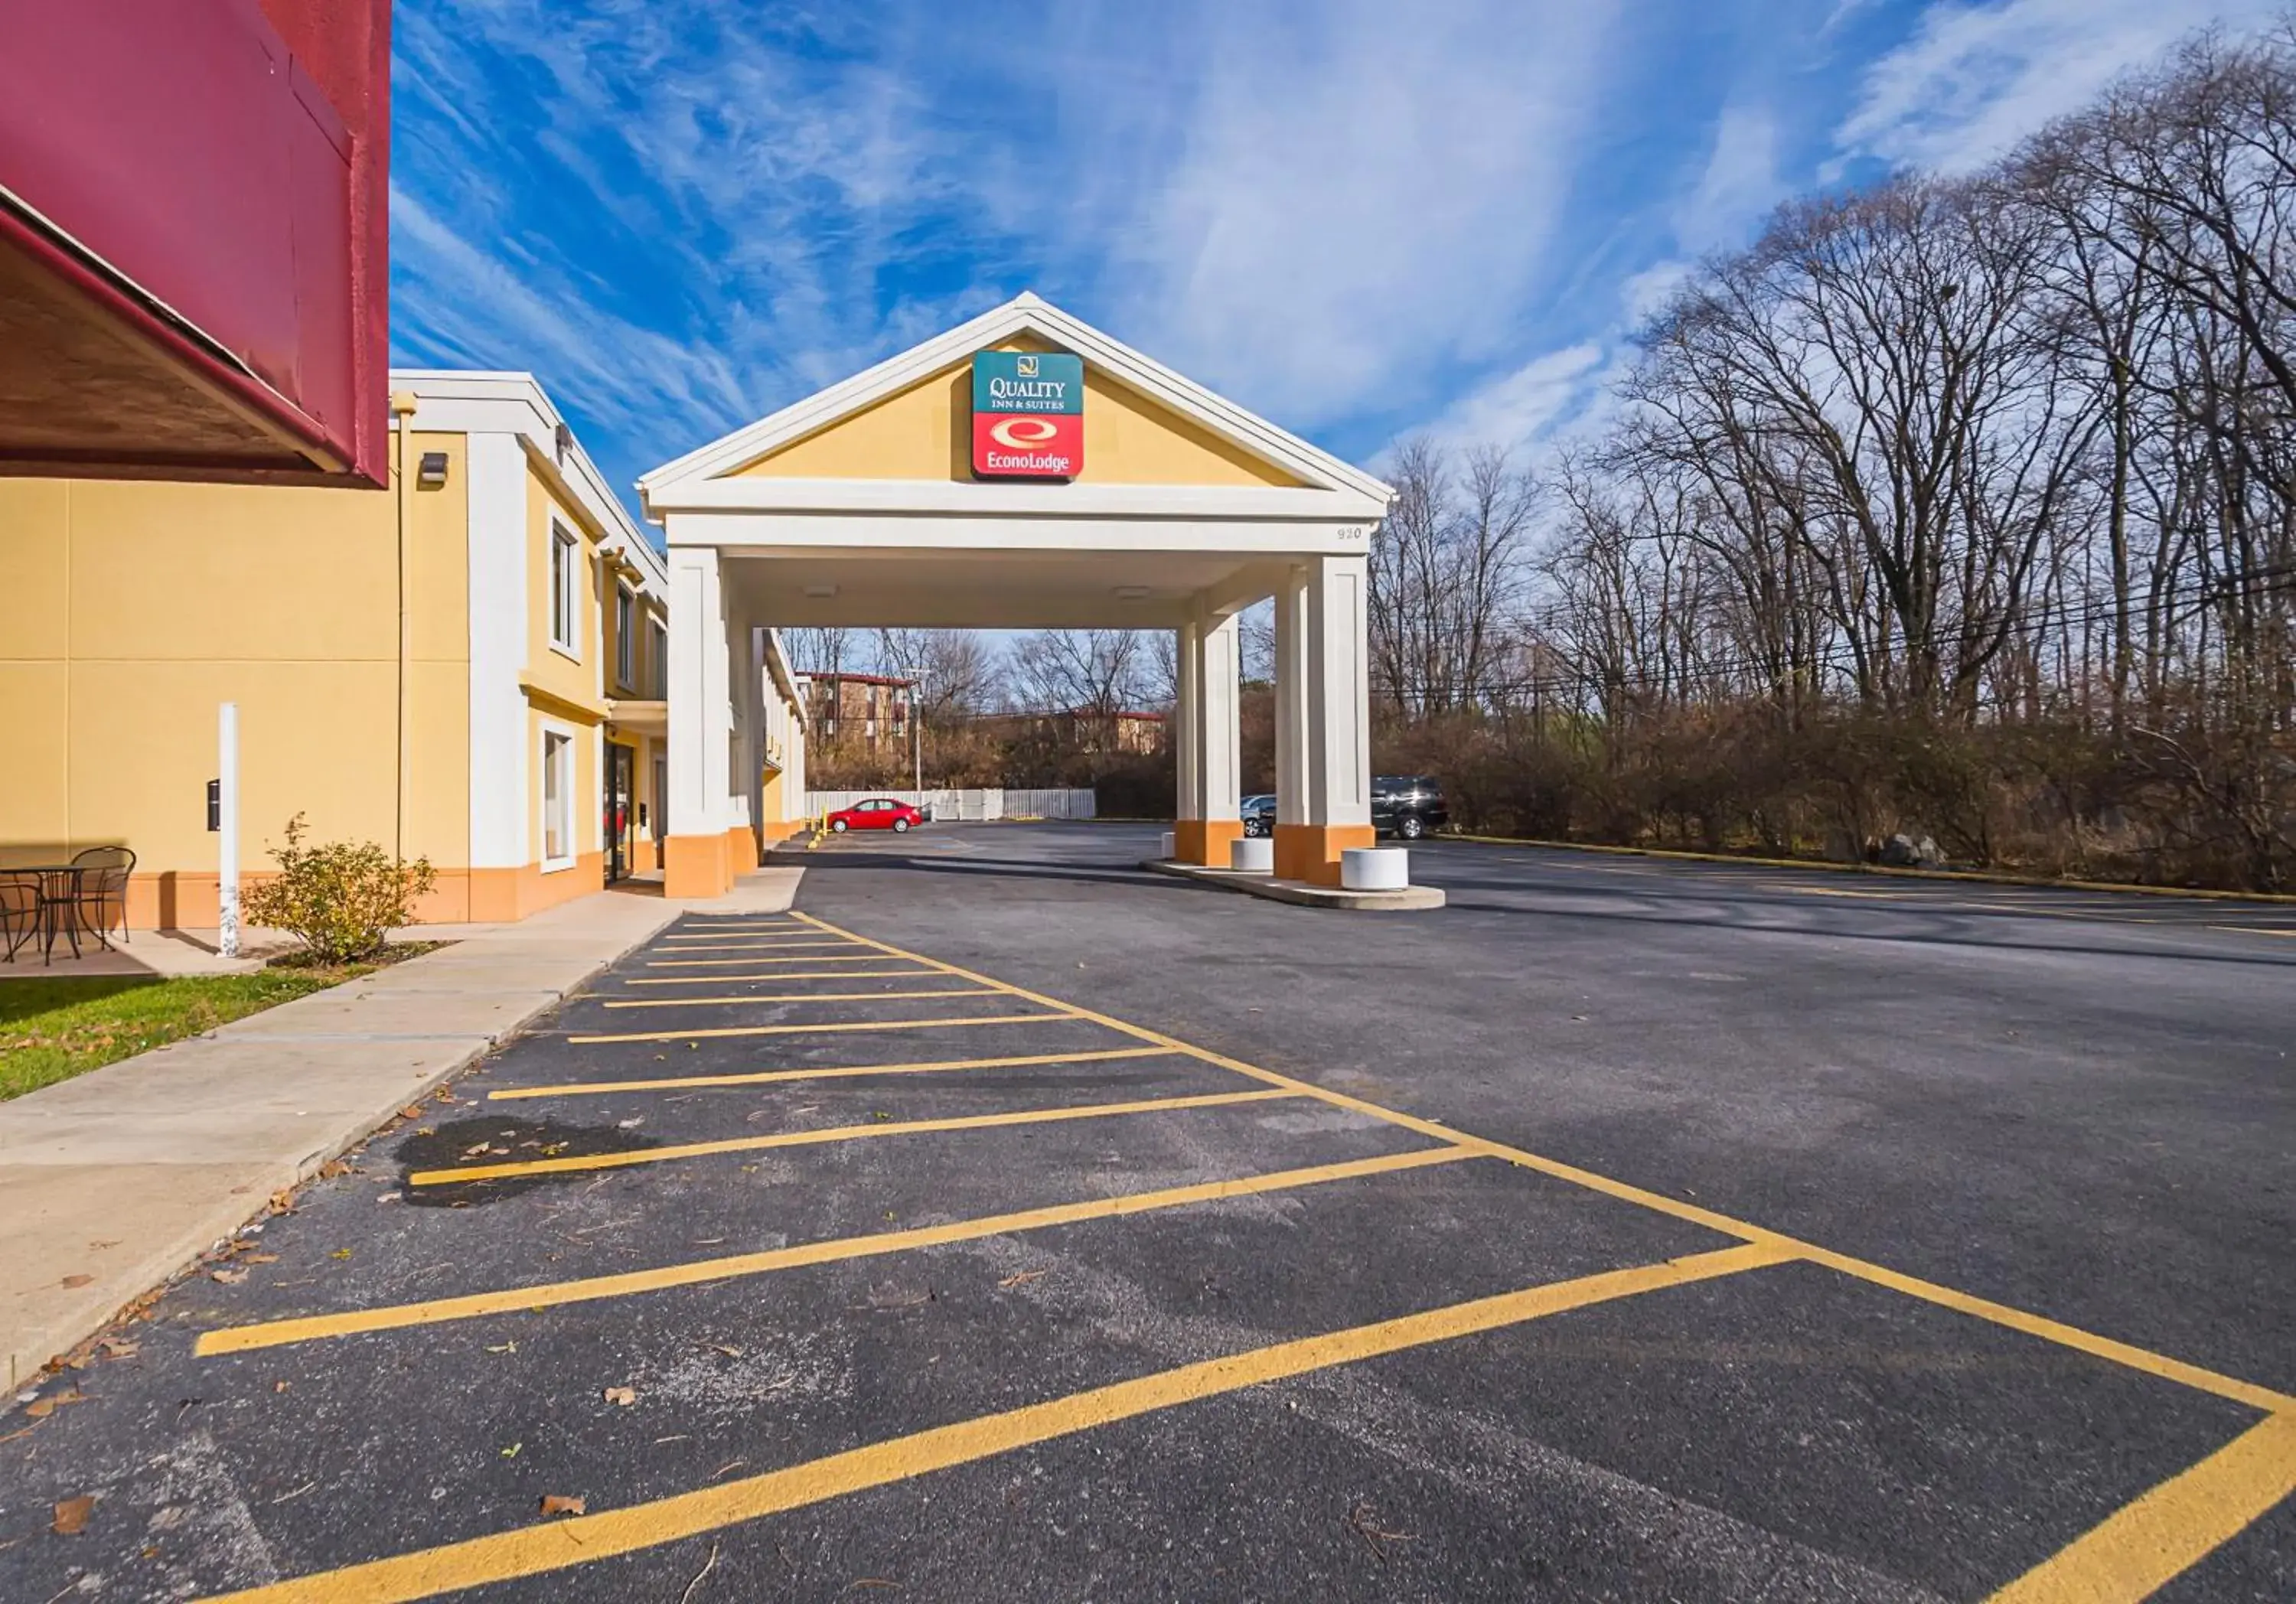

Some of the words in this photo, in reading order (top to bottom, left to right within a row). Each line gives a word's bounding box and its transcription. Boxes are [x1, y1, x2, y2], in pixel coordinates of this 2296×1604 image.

[990, 377, 1065, 399] QUALITY
[992, 400, 1013, 409] INN
[1016, 400, 1023, 409] &
[1026, 400, 1065, 410] SUITES
[987, 452, 1069, 472] EconoLodge
[1336, 527, 1362, 540] 920
